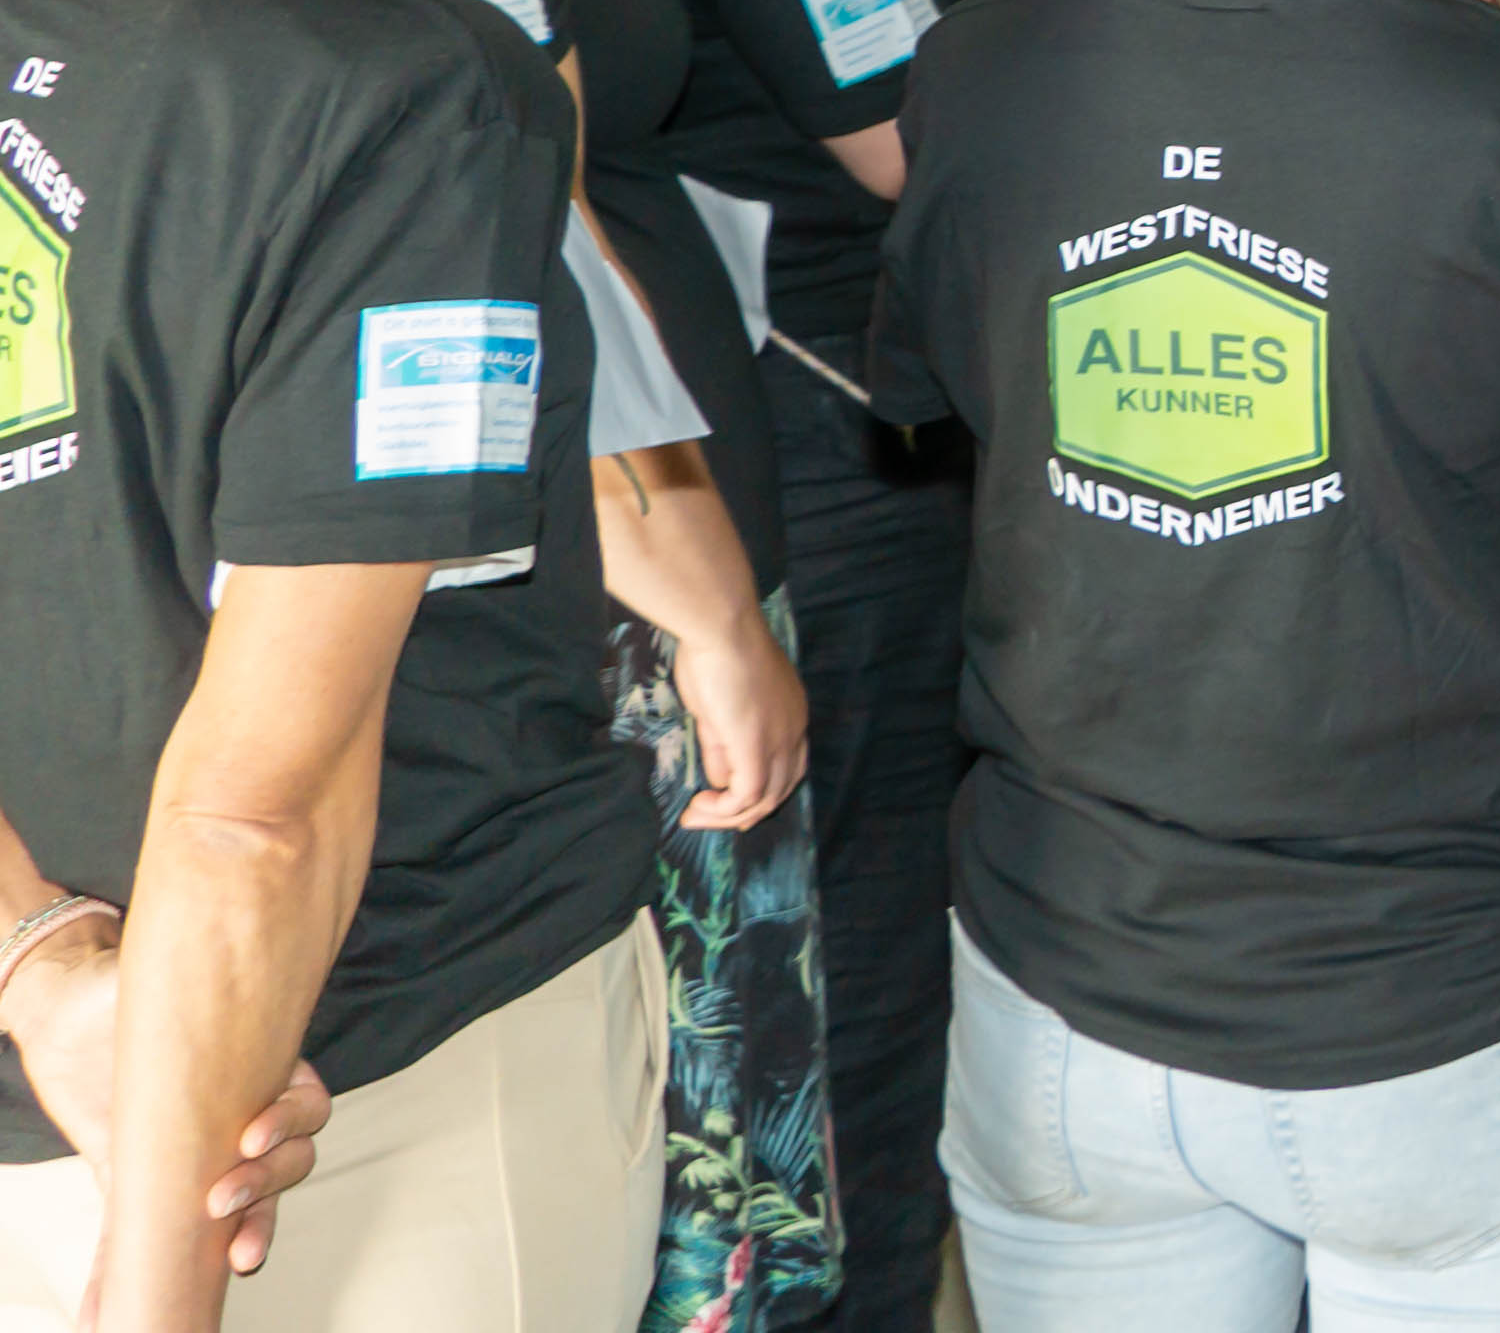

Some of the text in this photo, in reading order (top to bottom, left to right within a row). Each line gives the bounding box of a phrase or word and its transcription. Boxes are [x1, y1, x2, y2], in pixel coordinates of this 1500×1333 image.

[12, 56, 66, 99] DE
[0, 118, 87, 232] FRIESE
[1162, 145, 1223, 182] DE
[1058, 203, 1330, 300] WESTFRIESE
[1076, 329, 1289, 386] ALLES
[1115, 387, 1255, 421] KUNNER
[1047, 456, 1346, 547] ONDERNEMER
